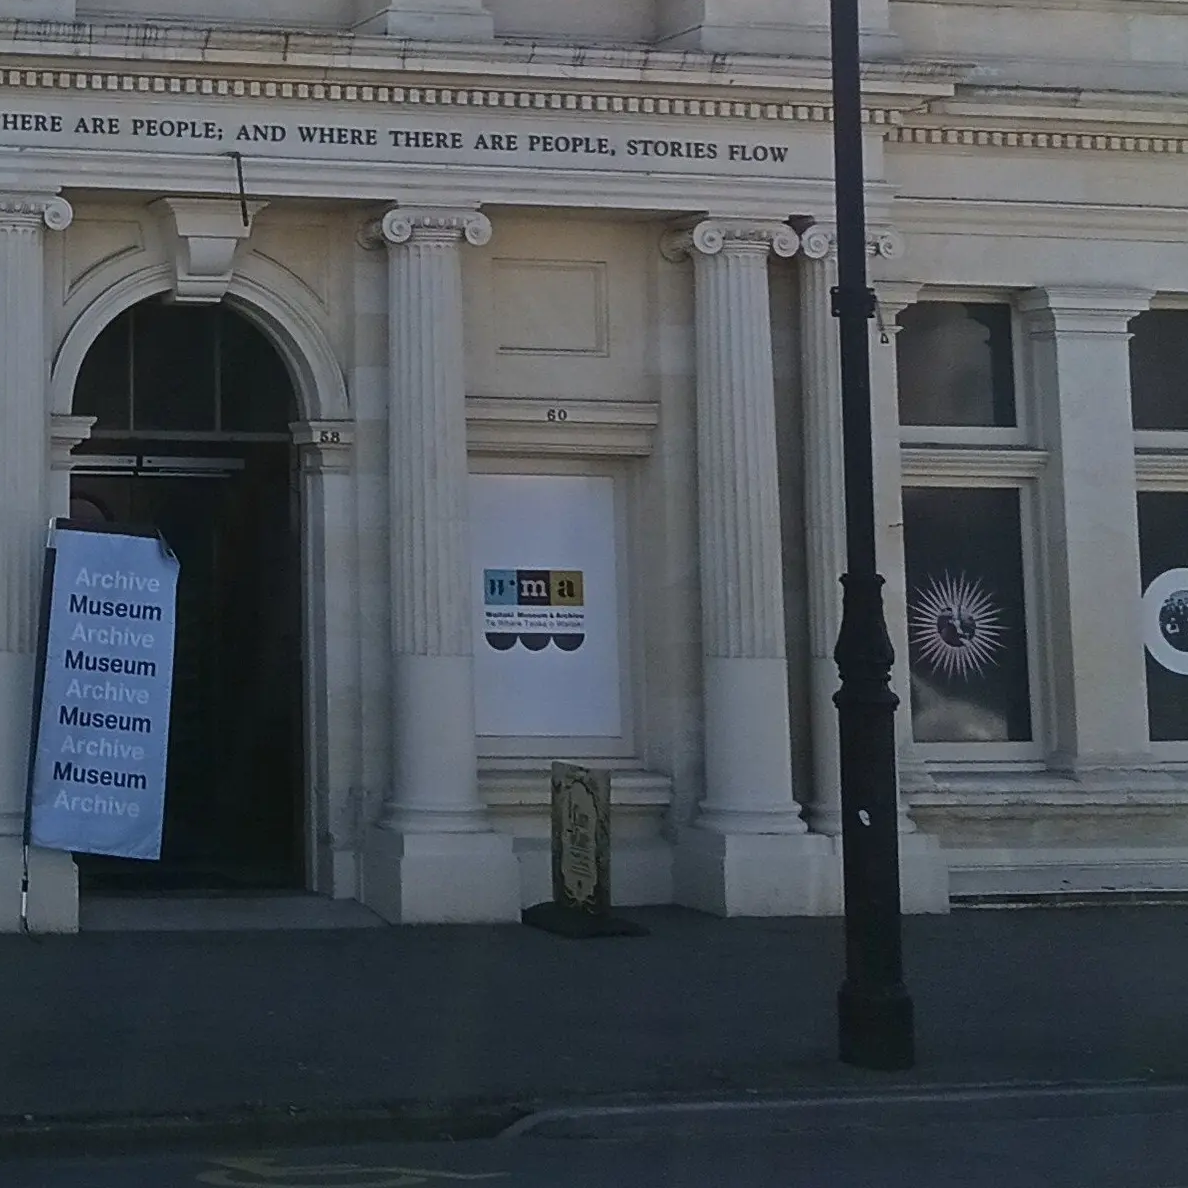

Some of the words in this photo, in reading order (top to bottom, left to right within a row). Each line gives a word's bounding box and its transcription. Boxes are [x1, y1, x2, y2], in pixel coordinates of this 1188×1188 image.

[73, 116, 120, 134] ARE
[131, 118, 223, 140] PEOPLE;
[235, 123, 286, 142] AND
[297, 126, 377, 146] WHERE
[388, 129, 463, 149] THERE
[473, 133, 518, 151] ARE
[528, 134, 616, 156] PEOPLE,
[626, 138, 717, 160] STORIES
[727, 143, 788, 162] FLOW
[547, 409, 568, 422] 60
[320, 431, 341, 444] 58
[75, 567, 160, 592] Archive
[69, 593, 162, 621] Museum
[70, 622, 155, 648] Archive
[64, 649, 156, 677] Museum
[66, 678, 150, 704] Archive
[59, 705, 151, 733] Museum
[60, 734, 145, 761] Archive
[53, 761, 147, 789] Museum
[53, 790, 140, 818] Archive
